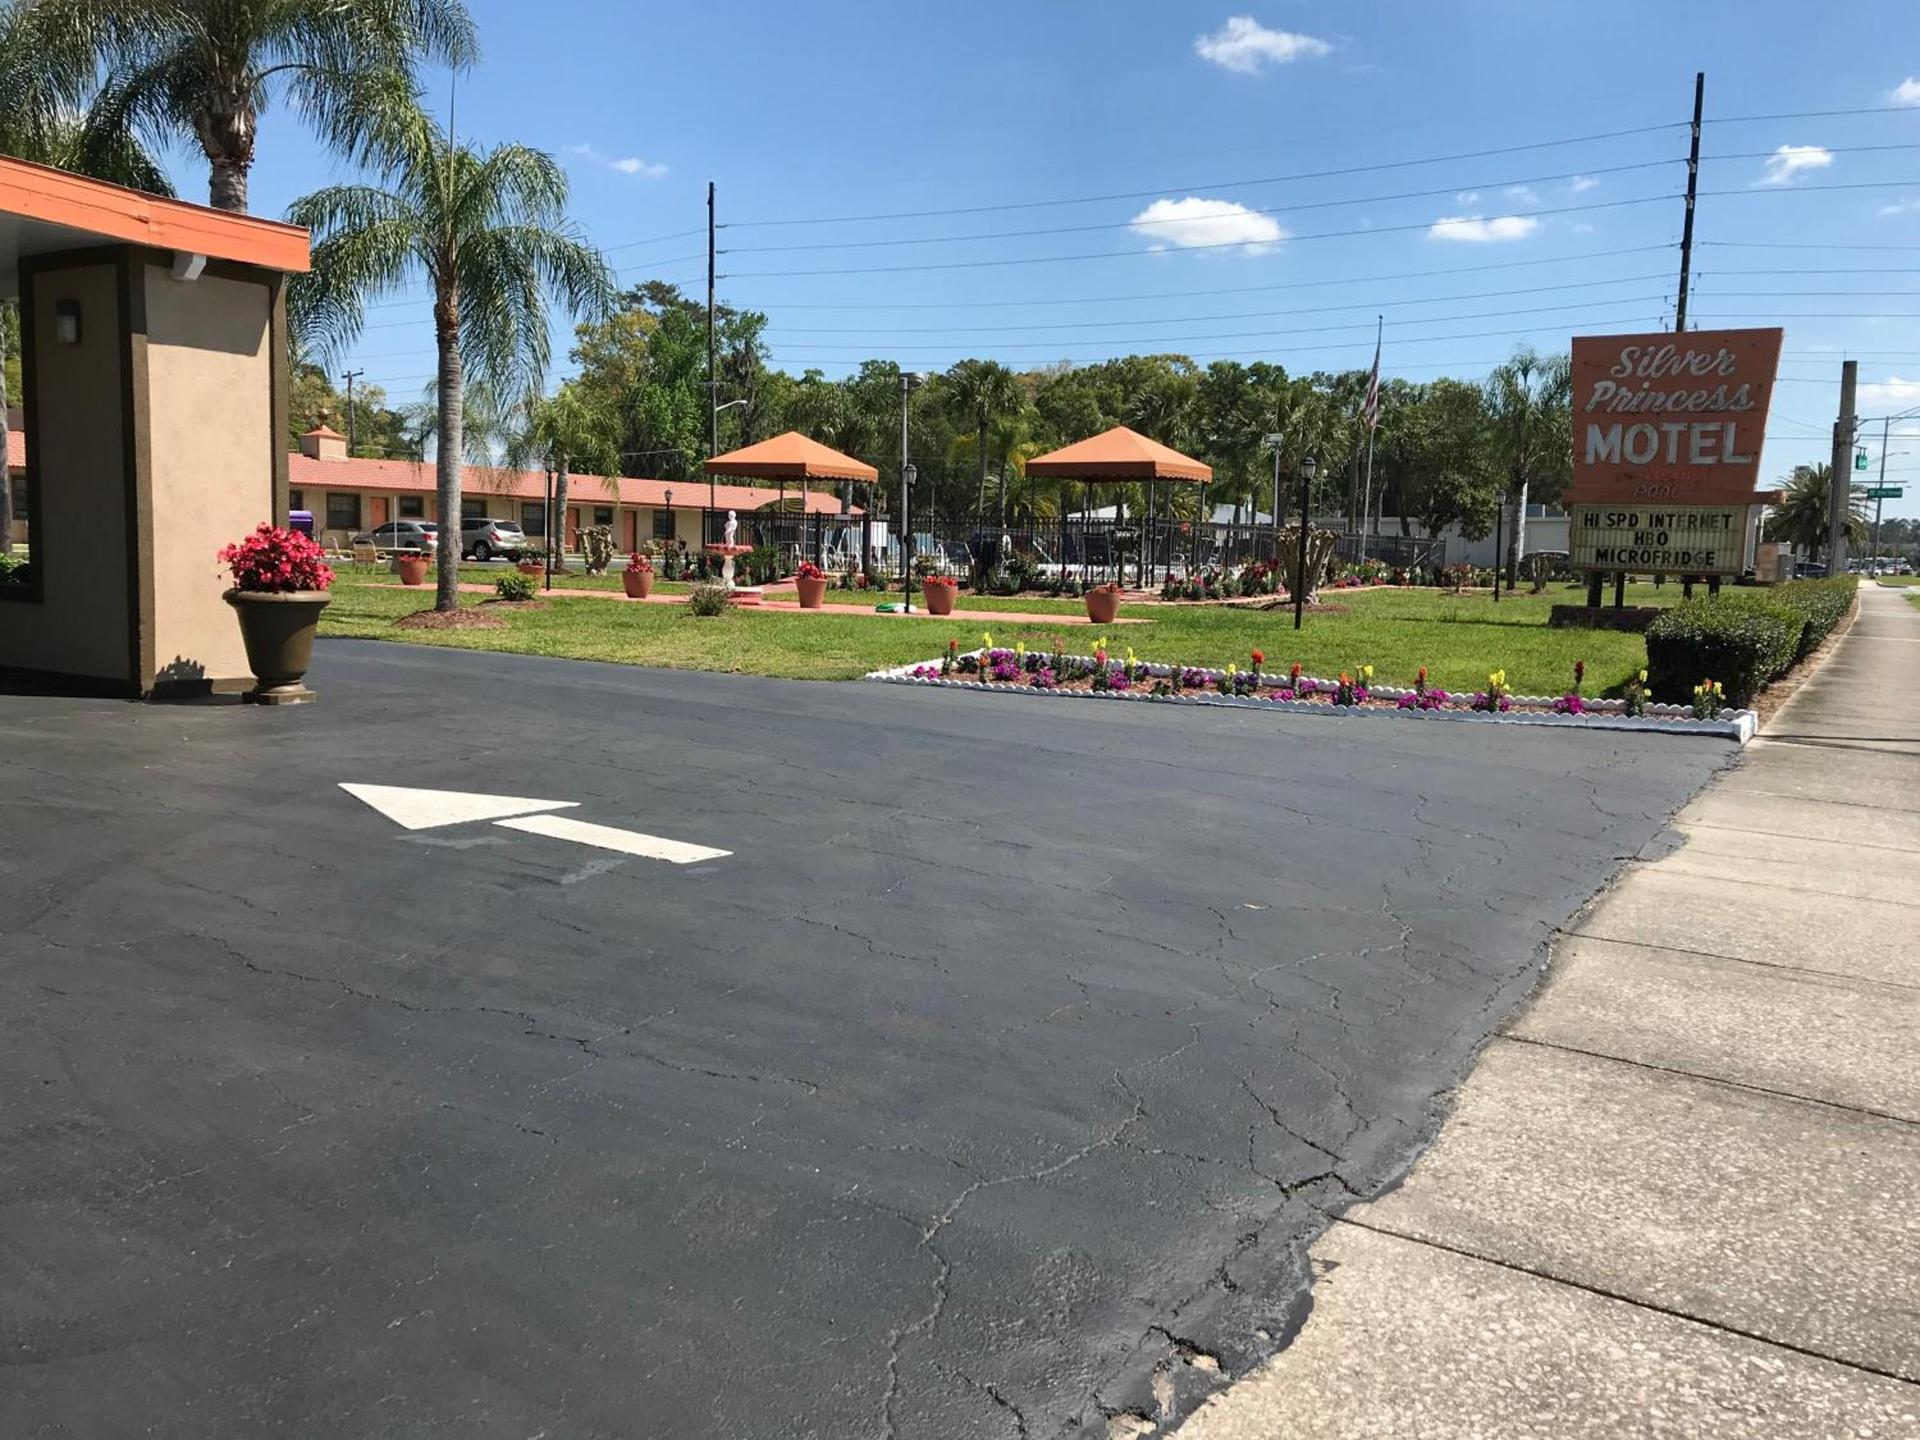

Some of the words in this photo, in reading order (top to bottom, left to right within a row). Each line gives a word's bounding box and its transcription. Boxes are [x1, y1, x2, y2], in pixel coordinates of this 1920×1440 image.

[1610, 344, 1736, 378] Silver
[1584, 380, 1755, 414] Princess
[1585, 422, 1752, 465] MOTEL
[1584, 512, 1599, 527] HI
[1607, 513, 1639, 527] SPD
[1649, 513, 1732, 529] INTERNET
[1634, 531, 1669, 546] HBO
[1596, 549, 1716, 566] MICROFRIDGE
